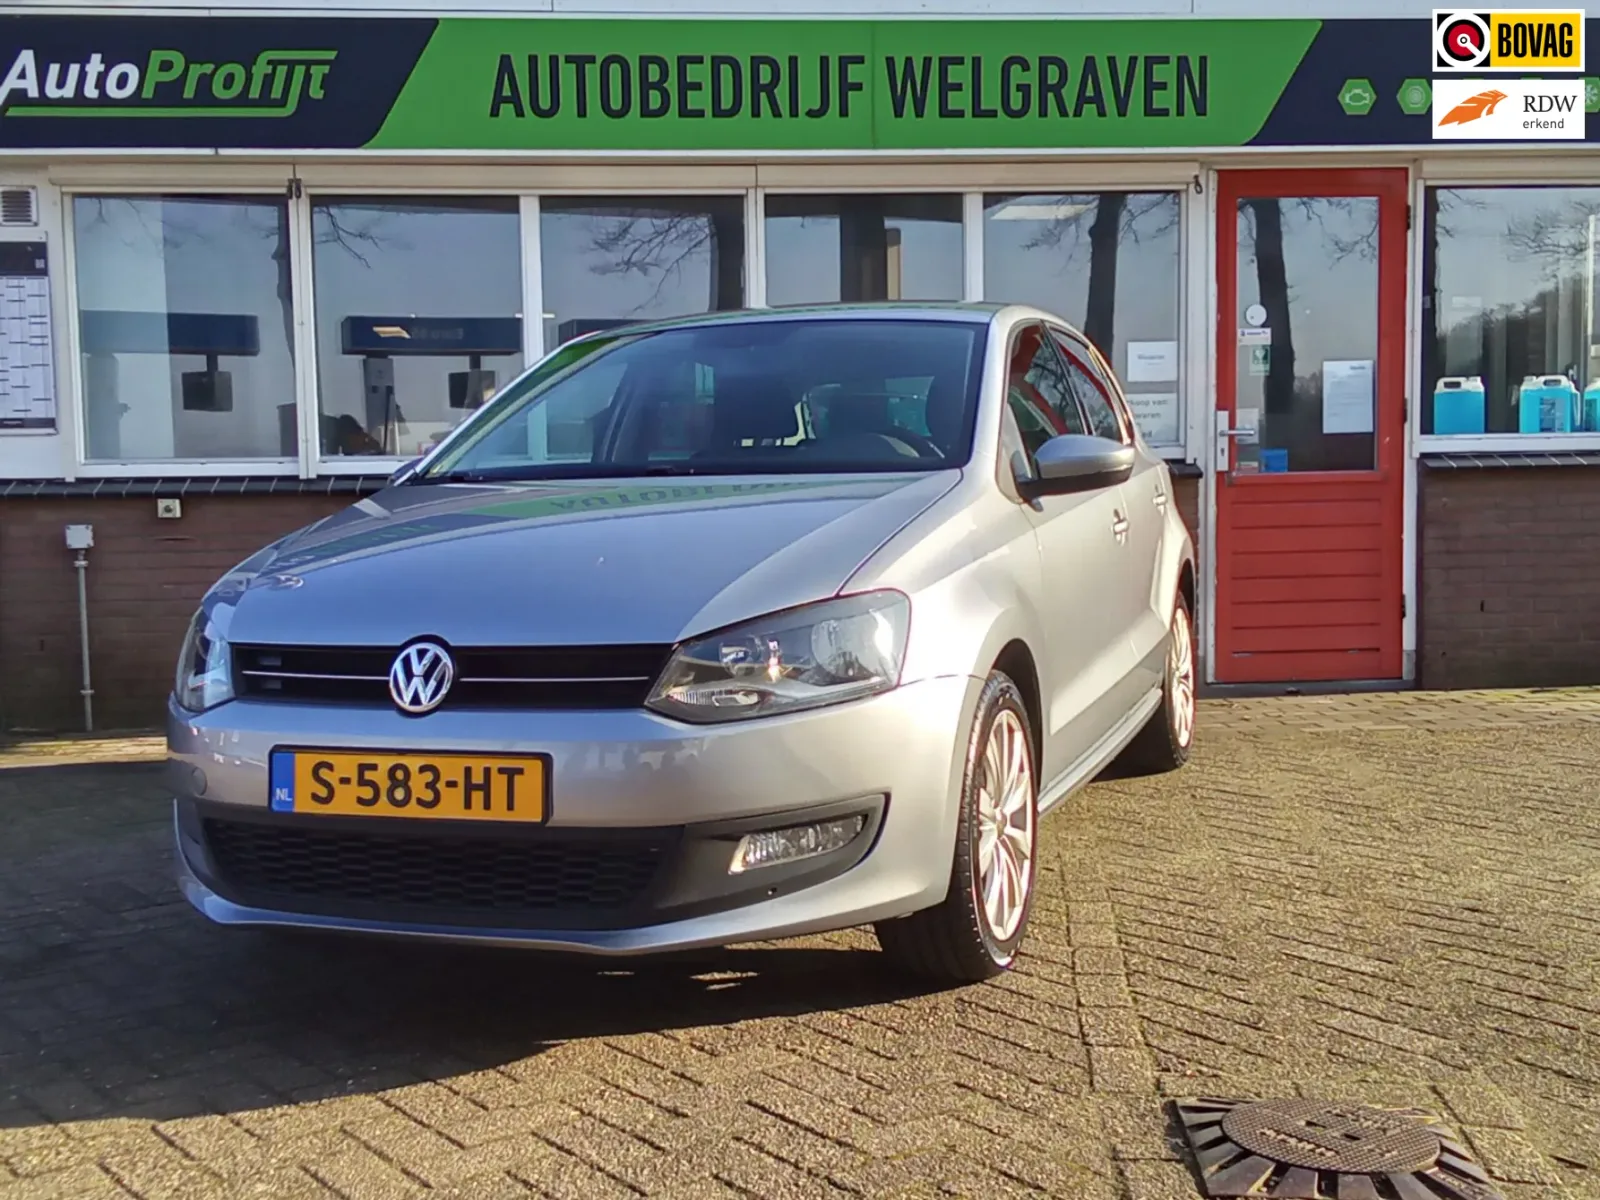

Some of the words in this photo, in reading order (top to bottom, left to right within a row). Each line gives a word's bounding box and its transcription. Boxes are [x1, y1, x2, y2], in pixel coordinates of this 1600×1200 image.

[489, 53, 865, 119] AUTOBEDRIJF
[885, 54, 1208, 119] WELGRAVEN
[275, 787, 293, 801] NL
[310, 760, 525, 812] S-583-HT
